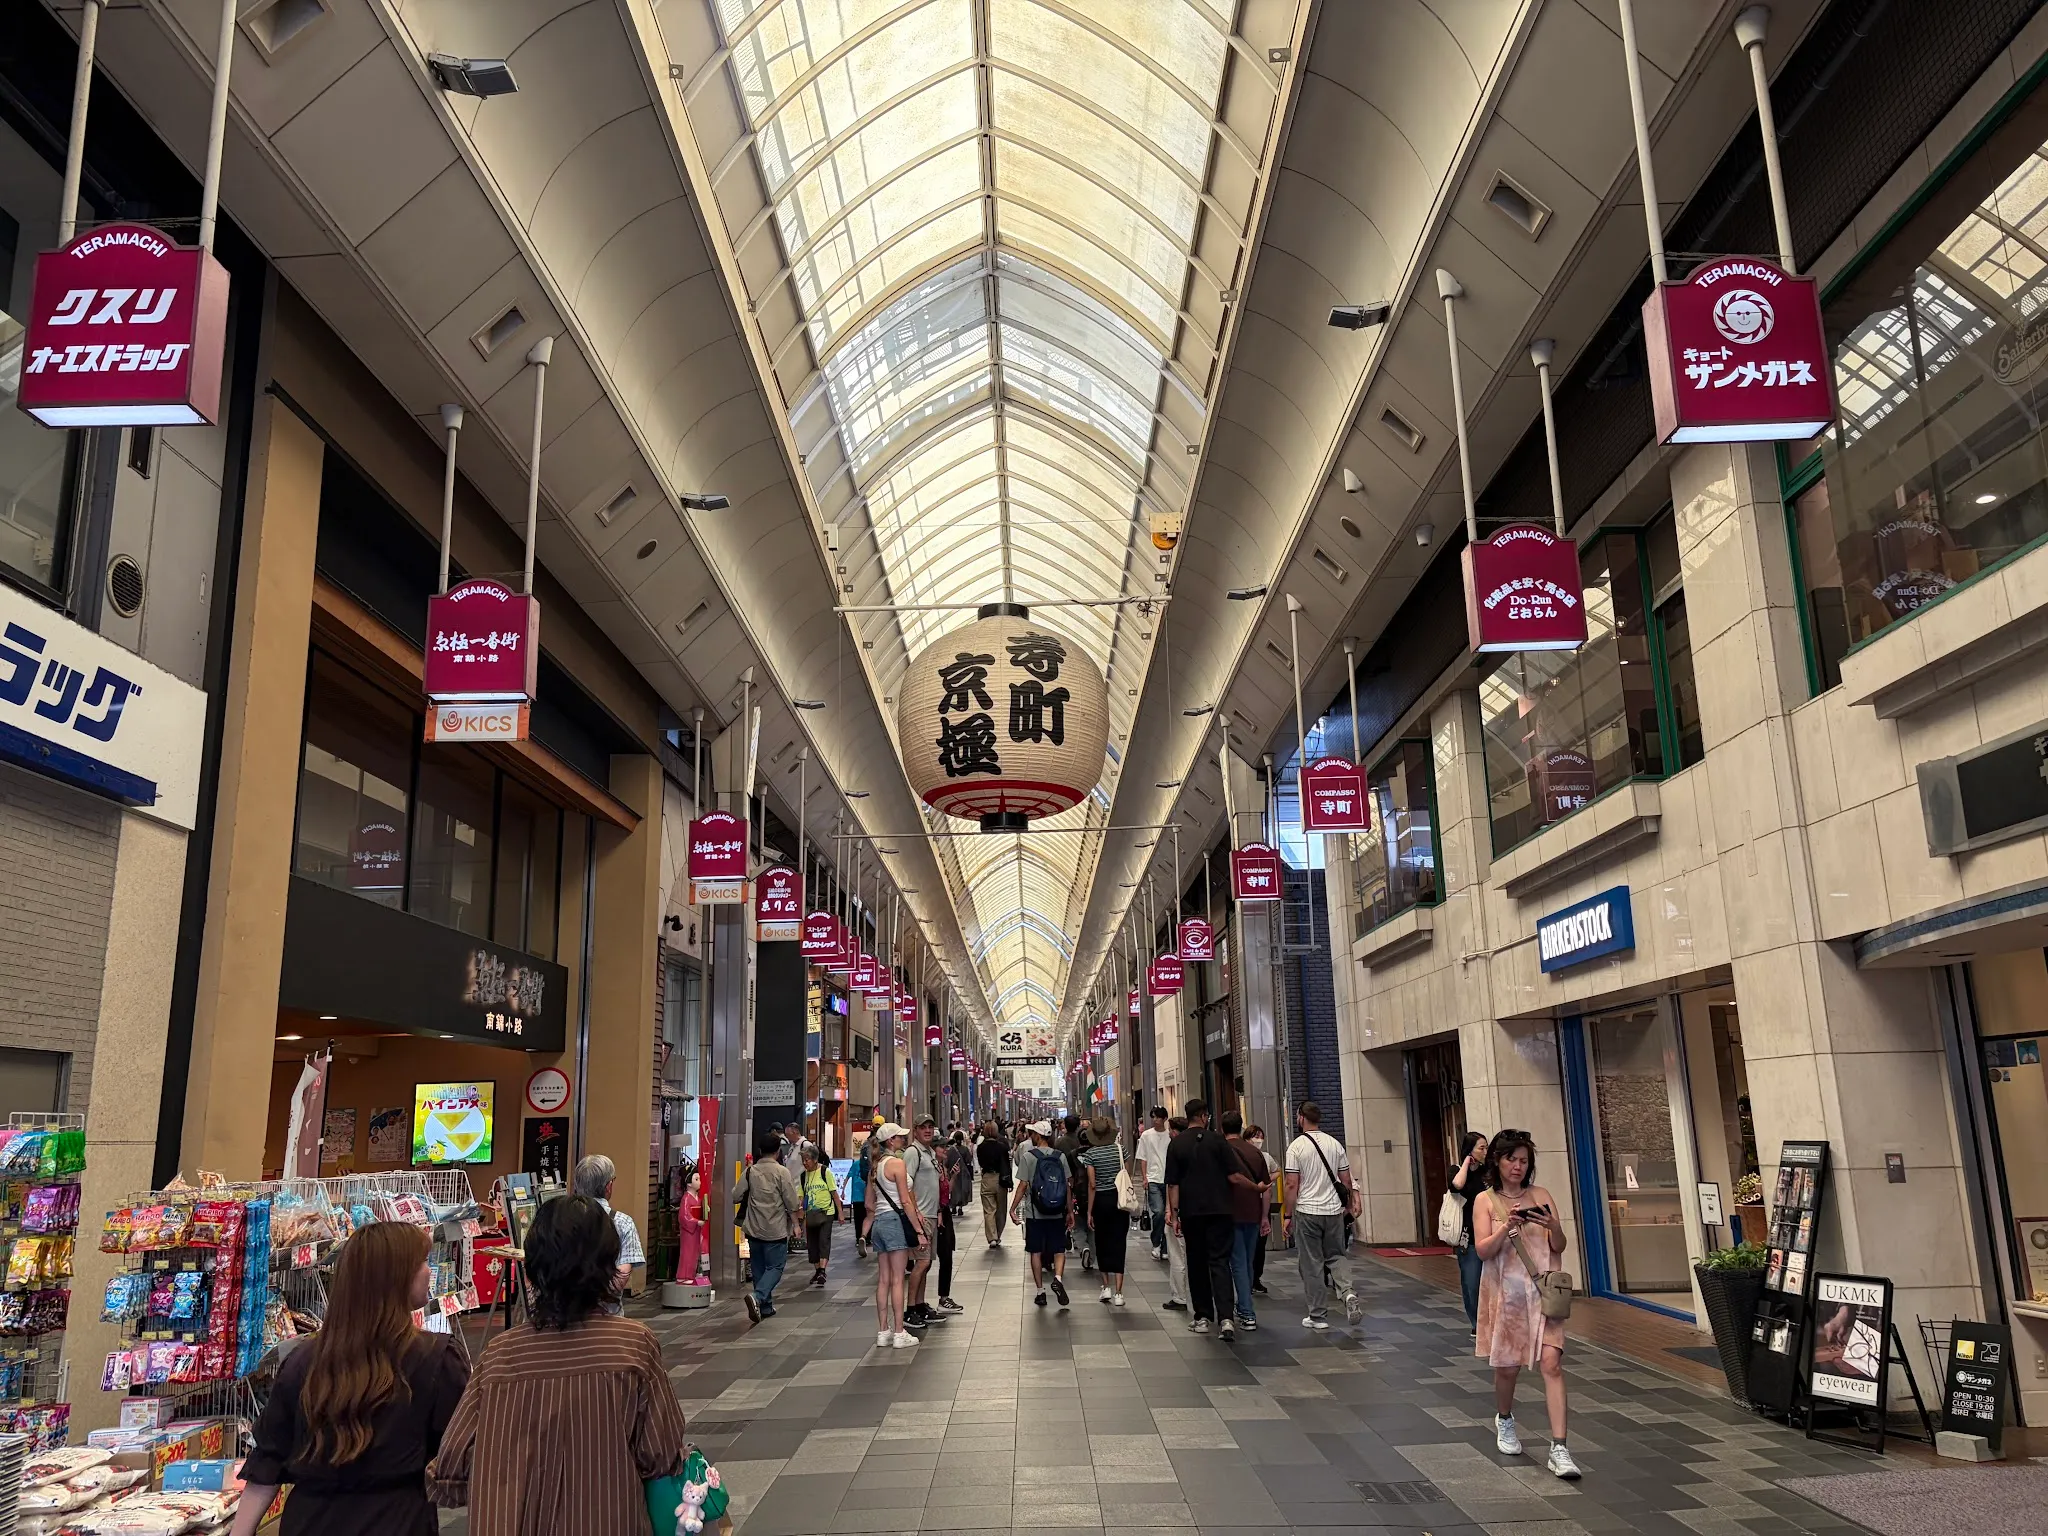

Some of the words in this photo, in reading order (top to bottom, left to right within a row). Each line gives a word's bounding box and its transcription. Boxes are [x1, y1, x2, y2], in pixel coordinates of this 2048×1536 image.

[71, 232, 169, 259] TERAMACHI
[1695, 263, 1783, 288] TERAMACHI
[47, 288, 178, 326] クスリ
[25, 343, 191, 374] オーエスドラッグ
[1683, 346, 1733, 362] キョート
[1684, 360, 1817, 389] サンメガネ
[1493, 530, 1555, 548] TERAMACHI
[450, 585, 509, 603] TERAMACHI
[1483, 576, 1577, 609] 化粧品を安く売る店
[1508, 606, 1558, 619] どおらん
[432, 630, 521, 652] 京極一番街
[1006, 631, 1070, 746] 寺町
[936, 652, 1002, 777] 京極
[464, 715, 512, 732] KICS
[1313, 760, 1353, 772] TERAMACHI
[1314, 789, 1356, 797] COMPASSO
[1320, 800, 1352, 815] 寺町
[701, 813, 736, 825] TERAMACHI
[1241, 843, 1271, 853] TERAMACHI
[766, 867, 794, 876] TERAMACHI
[1246, 875, 1270, 887] 寺町
[711, 889, 739, 899] KICS
[773, 928, 797, 937] KICS
[806, 925, 833, 933] ストレッチ
[1540, 901, 1613, 961] BIRKENSTOCK
[1000, 1032, 1022, 1045] くら
[197, 1208, 224, 1217] HARIBO
[1825, 1284, 1879, 1303] UKMK
[1819, 1376, 1872, 1393] eyewear
[1952, 1391, 1972, 1400] OPEN
[1974, 1394, 1995, 1403] 10:30
[1952, 1399, 1974, 1409] CLOSE
[1951, 1407, 1969, 1416] 定休日
[1975, 1412, 1994, 1420] 水曜日
